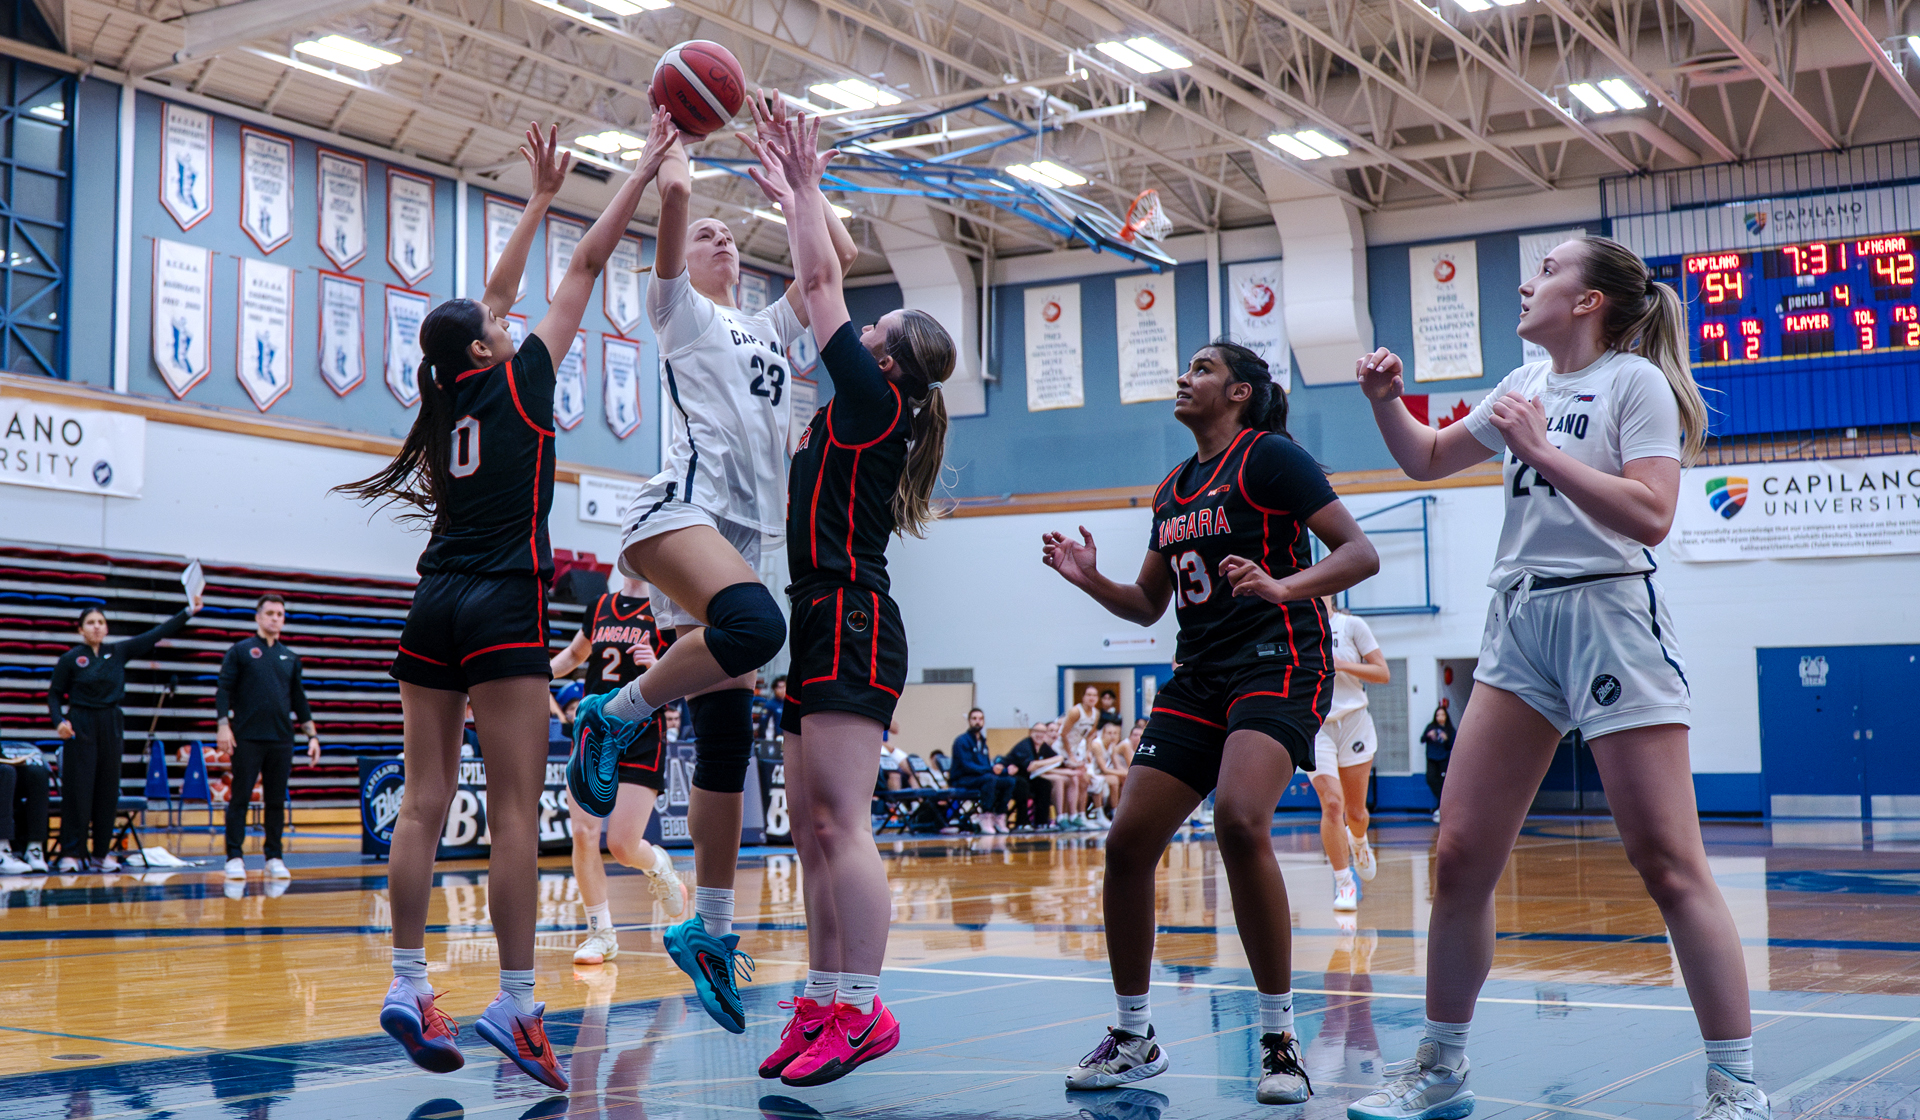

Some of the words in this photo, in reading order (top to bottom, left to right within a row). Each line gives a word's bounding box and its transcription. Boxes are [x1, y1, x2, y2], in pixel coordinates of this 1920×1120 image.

[1774, 202, 1862, 222] CAPILANO
[1776, 215, 1860, 232] UNVRSTY
[1687, 255, 1740, 274] CAPILANO
[1782, 242, 1848, 276] 7:31
[1876, 253, 1915, 286] 42
[1705, 271, 1743, 304] 54
[1788, 291, 1825, 312] period
[1834, 284, 1850, 307] 4
[1785, 313, 1831, 332] PLAYER
[1854, 309, 1876, 326] TOL
[1894, 305, 1918, 322] FLS
[1418, 321, 1475, 333] CHAMPIONS
[1740, 319, 1762, 336] TOL
[1860, 326, 1874, 351] 3
[1906, 322, 1920, 347] 2
[1722, 339, 1729, 362] 1
[1745, 336, 1760, 361] 2
[749, 354, 786, 408] 23
[449, 414, 481, 479] 0
[1762, 468, 1920, 496] CAPILANO
[1764, 493, 1920, 516] UNIVERSITY
[1171, 549, 1212, 609] 13
[602, 646, 621, 682] 2
[370, 784, 405, 833] Blue
